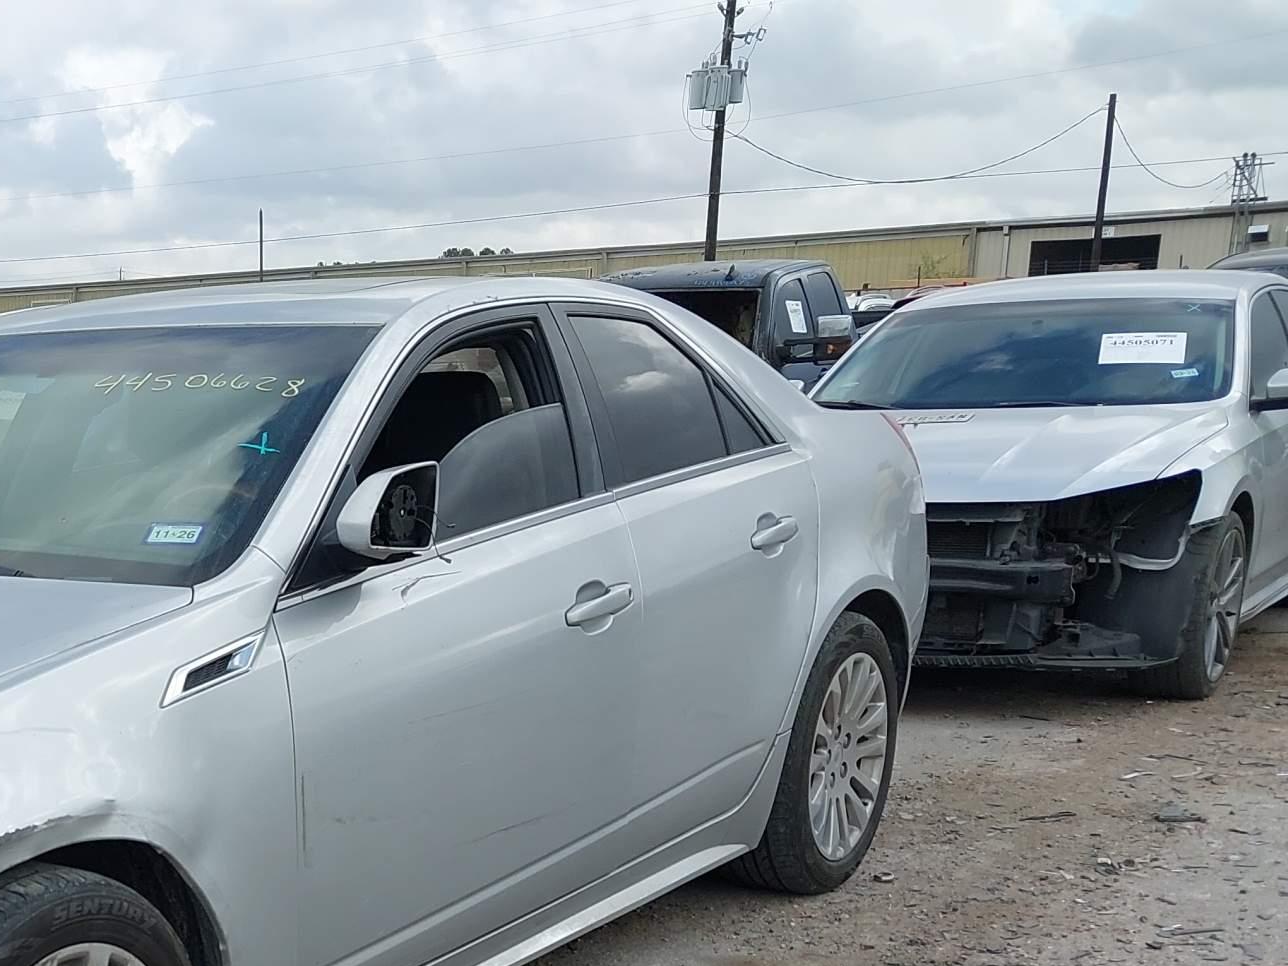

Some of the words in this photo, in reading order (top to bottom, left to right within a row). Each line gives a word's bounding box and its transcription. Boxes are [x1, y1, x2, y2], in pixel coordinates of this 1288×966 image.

[1109, 338, 1175, 346] 44505071
[94, 372, 305, 398] 44506628
[52, 899, 159, 930] SENTURY
